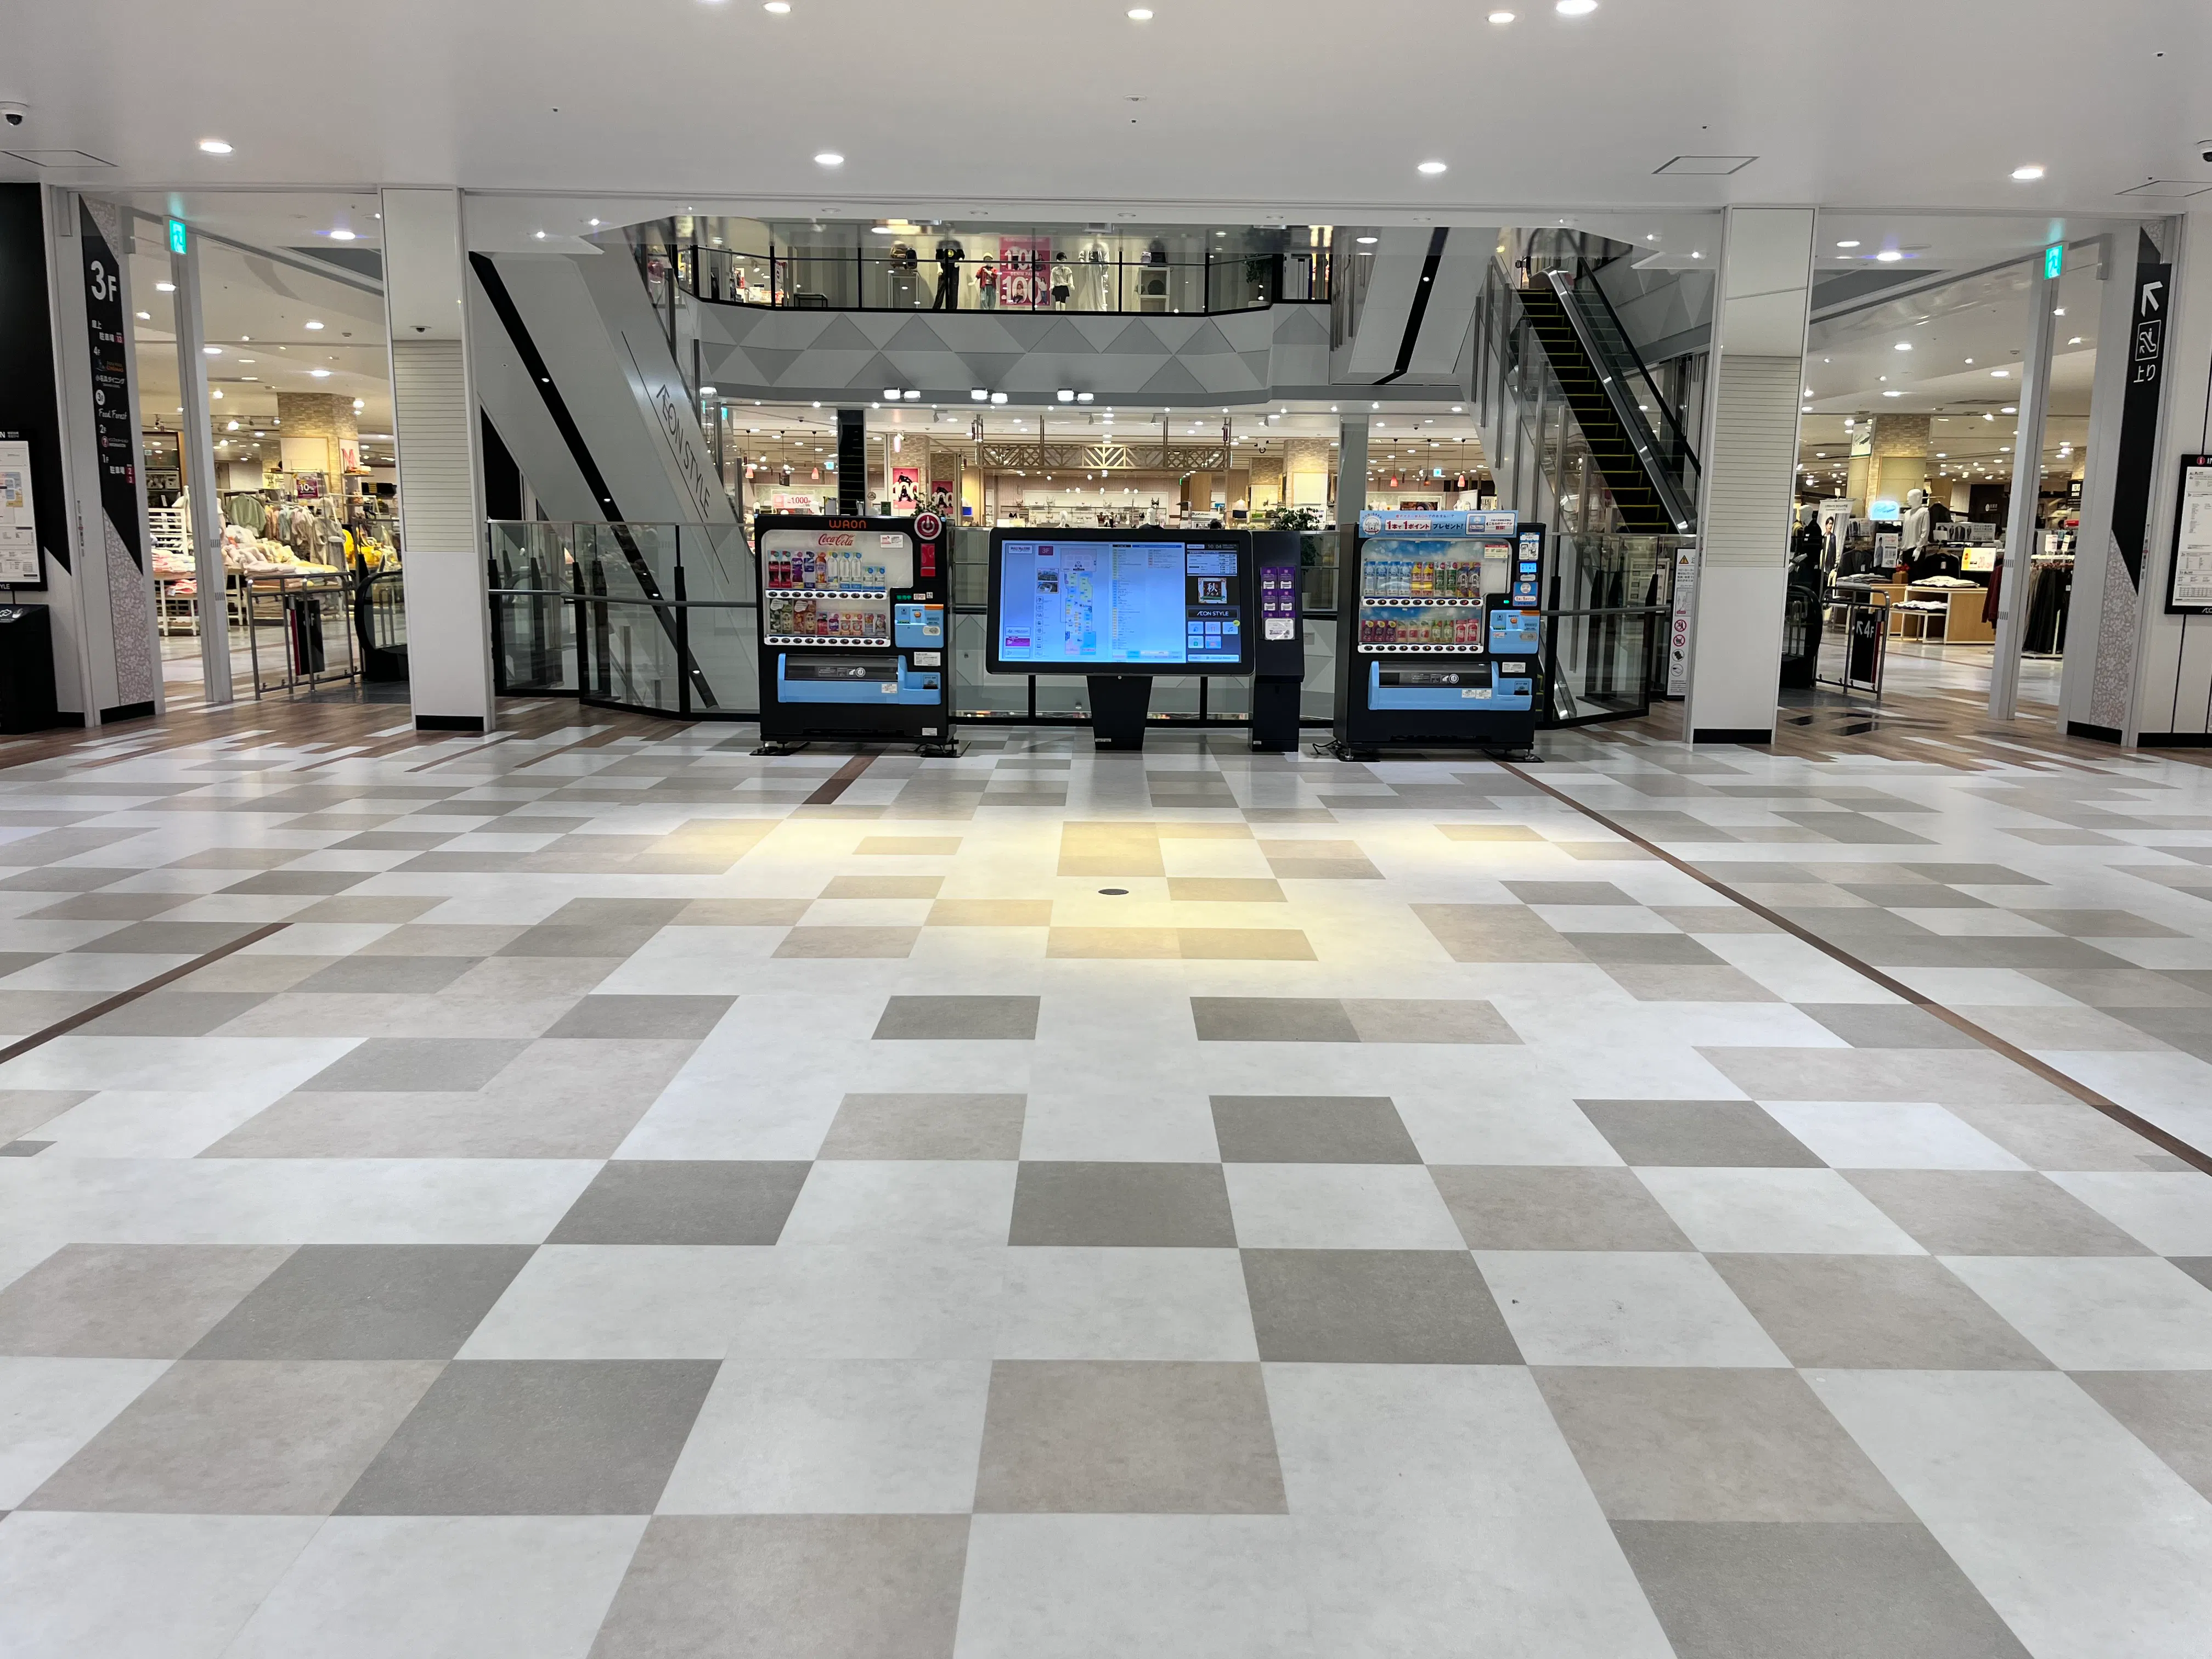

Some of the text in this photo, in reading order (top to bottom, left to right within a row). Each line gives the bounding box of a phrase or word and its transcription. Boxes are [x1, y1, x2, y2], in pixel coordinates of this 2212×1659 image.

[91, 261, 117, 302] 3F
[1002, 276, 1042, 304] 100
[93, 346, 101, 356] 4F
[2133, 364, 2156, 383] 上り
[97, 392, 104, 402] 3F
[111, 409, 127, 420] Forest
[99, 424, 107, 434] 2F
[101, 454, 109, 464] 1F
[893, 481, 919, 502] 100
[829, 520, 867, 529] WAON
[818, 533, 855, 546] Coca-Cola
[1207, 582, 1217, 592] 秋
[1864, 620, 1875, 639] 4F
